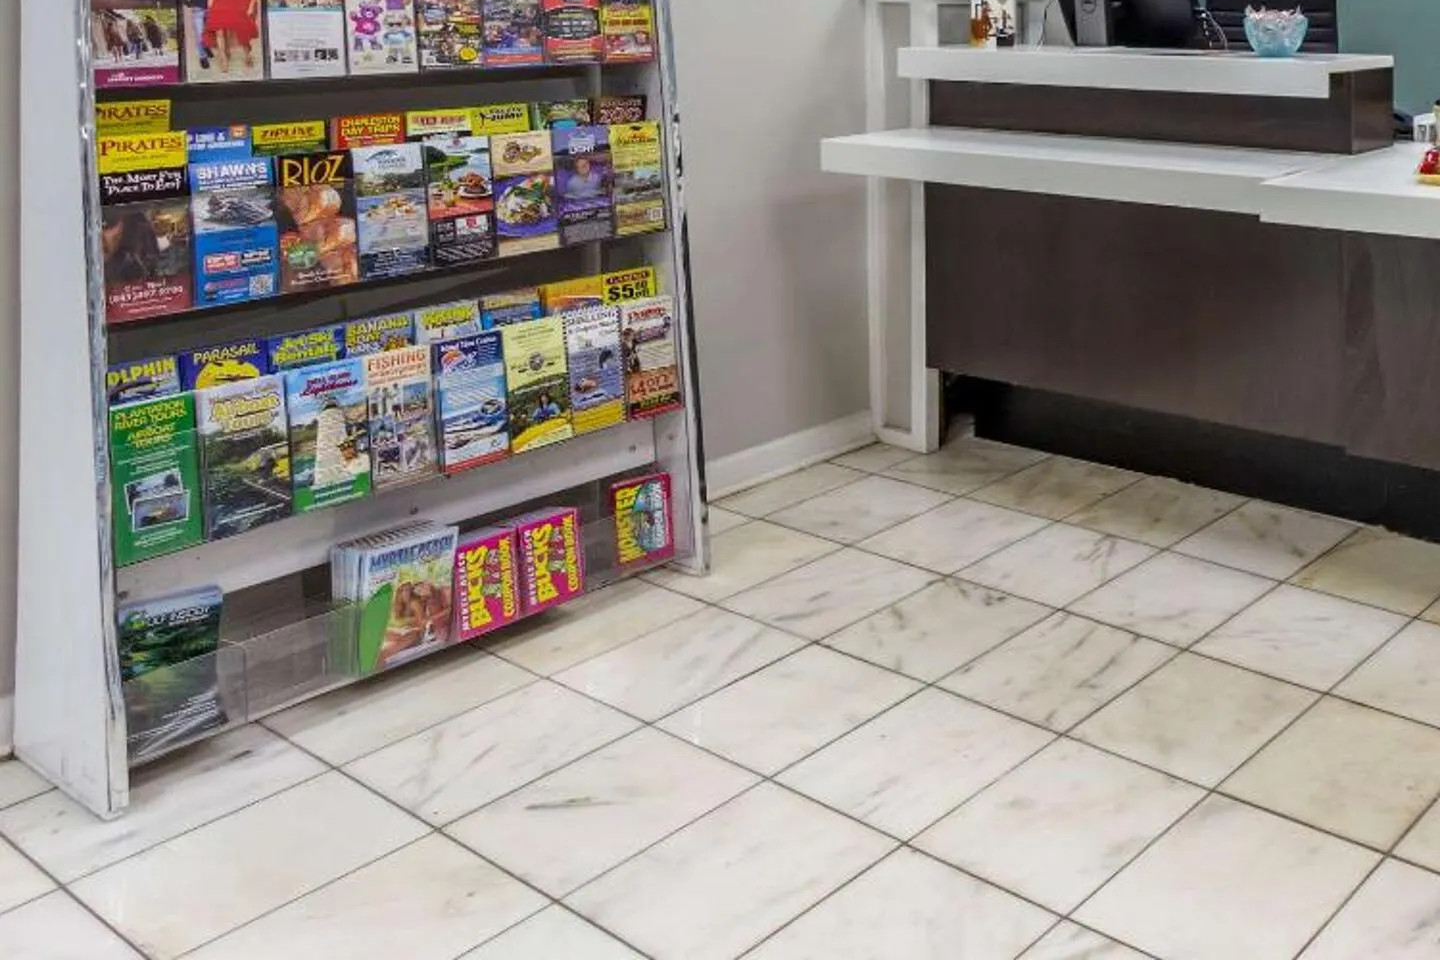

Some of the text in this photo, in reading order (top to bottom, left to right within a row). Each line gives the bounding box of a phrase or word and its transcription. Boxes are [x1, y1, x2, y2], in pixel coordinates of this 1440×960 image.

[100, 134, 183, 158] PIRATES
[283, 154, 346, 188] RIOZ
[193, 343, 260, 365] PARASAIL
[367, 348, 426, 371] FISHING
[616, 484, 648, 565] MONSTER
[532, 523, 560, 603] BUCKS
[565, 546, 579, 593] COUPON
[466, 545, 493, 629] BUCKS
[500, 571, 515, 617] COUPON
